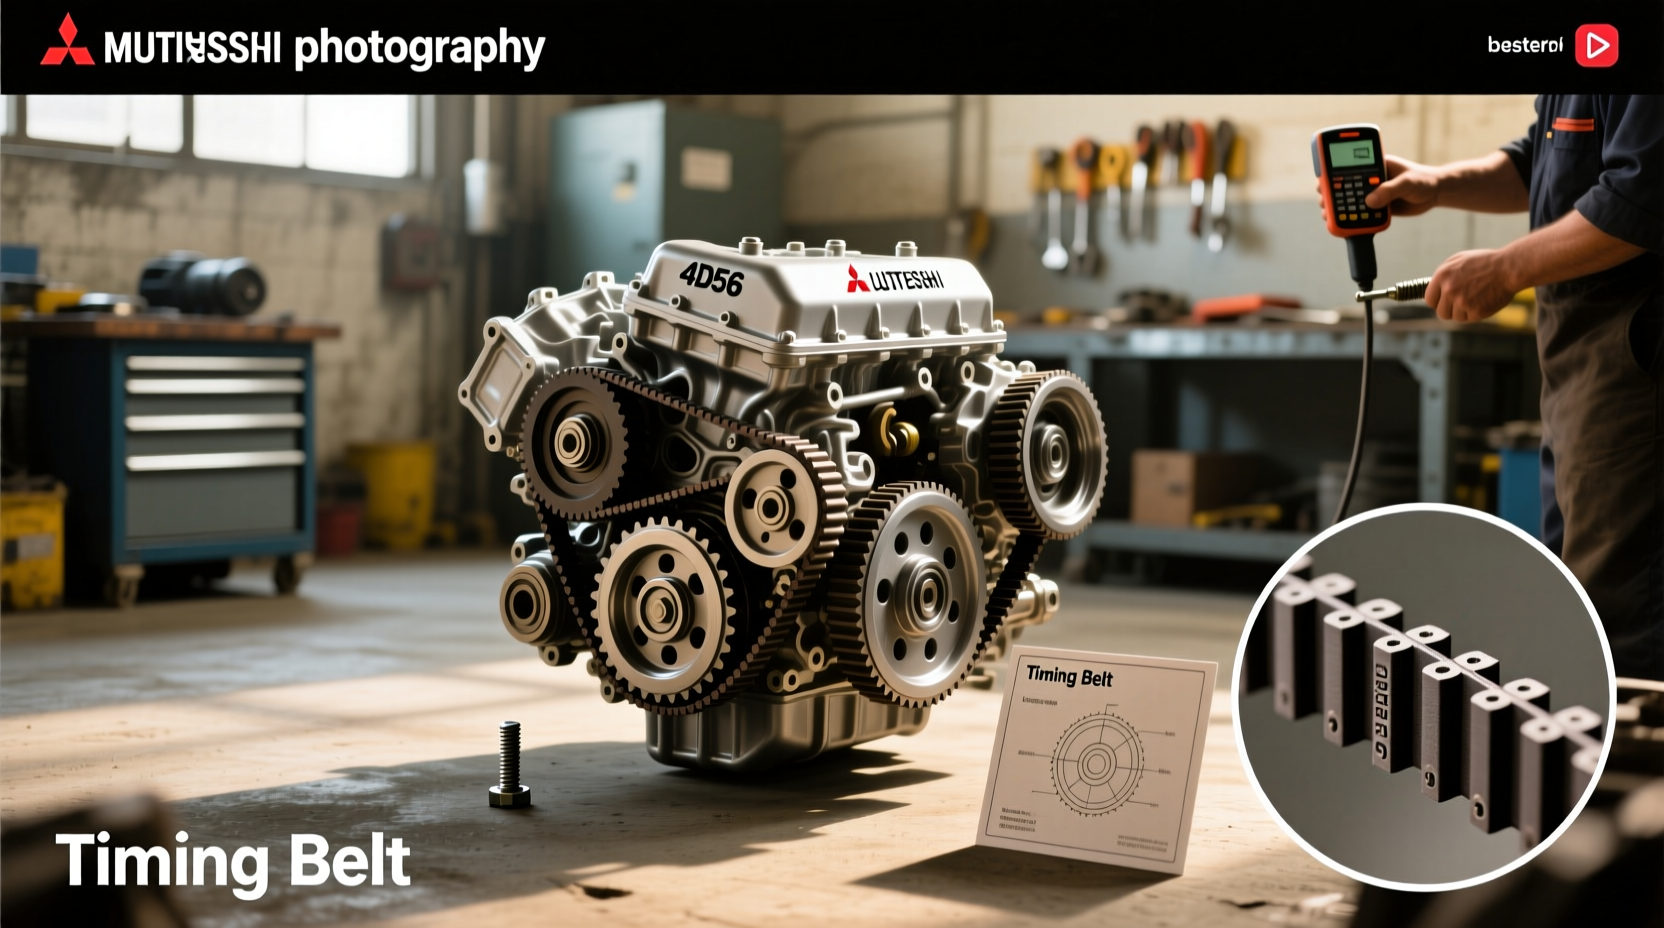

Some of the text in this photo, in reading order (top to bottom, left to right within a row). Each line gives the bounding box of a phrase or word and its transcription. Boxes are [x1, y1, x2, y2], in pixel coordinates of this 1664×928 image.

[679, 261, 745, 297] 4D56
[1026, 664, 1114, 688] Timing Belt
